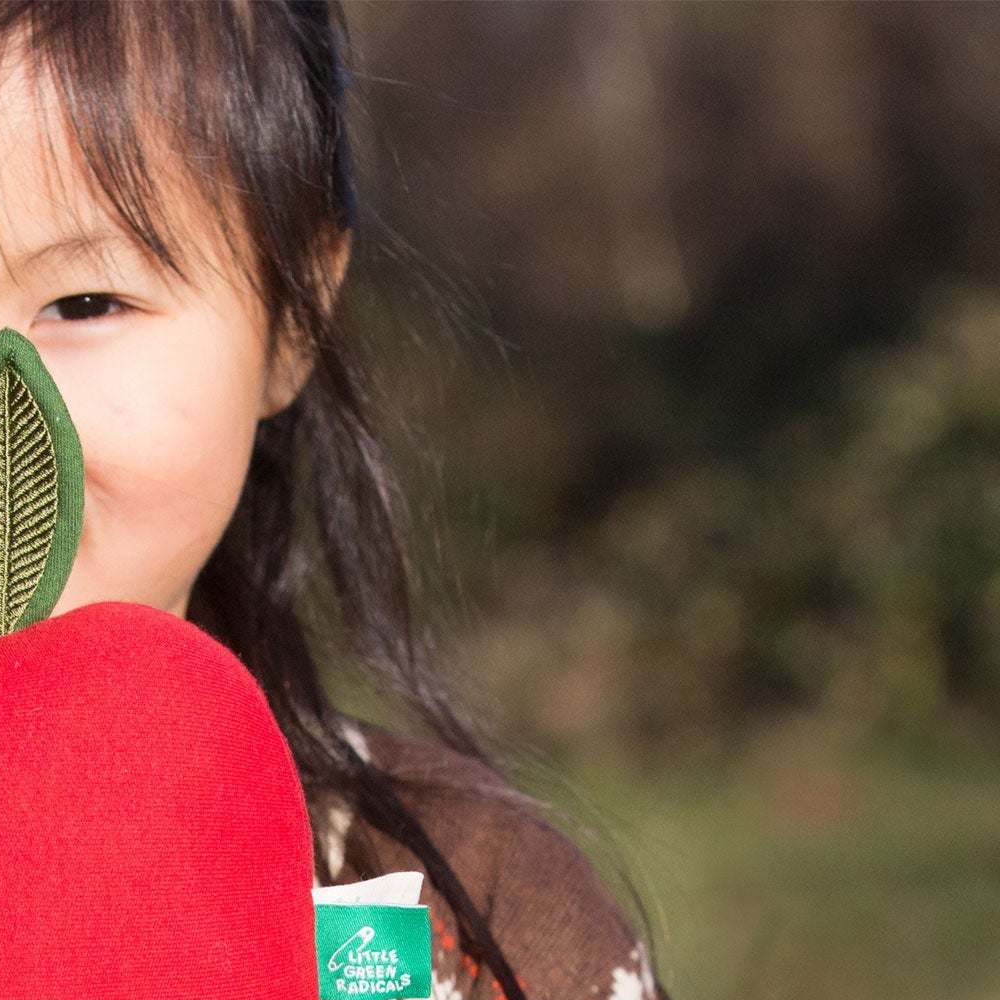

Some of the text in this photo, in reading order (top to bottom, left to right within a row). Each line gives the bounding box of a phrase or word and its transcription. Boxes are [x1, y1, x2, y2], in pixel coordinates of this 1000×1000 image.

[348, 949, 399, 964] LITTLE
[343, 965, 397, 979] GREEN
[336, 973, 411, 994] RADICALS
